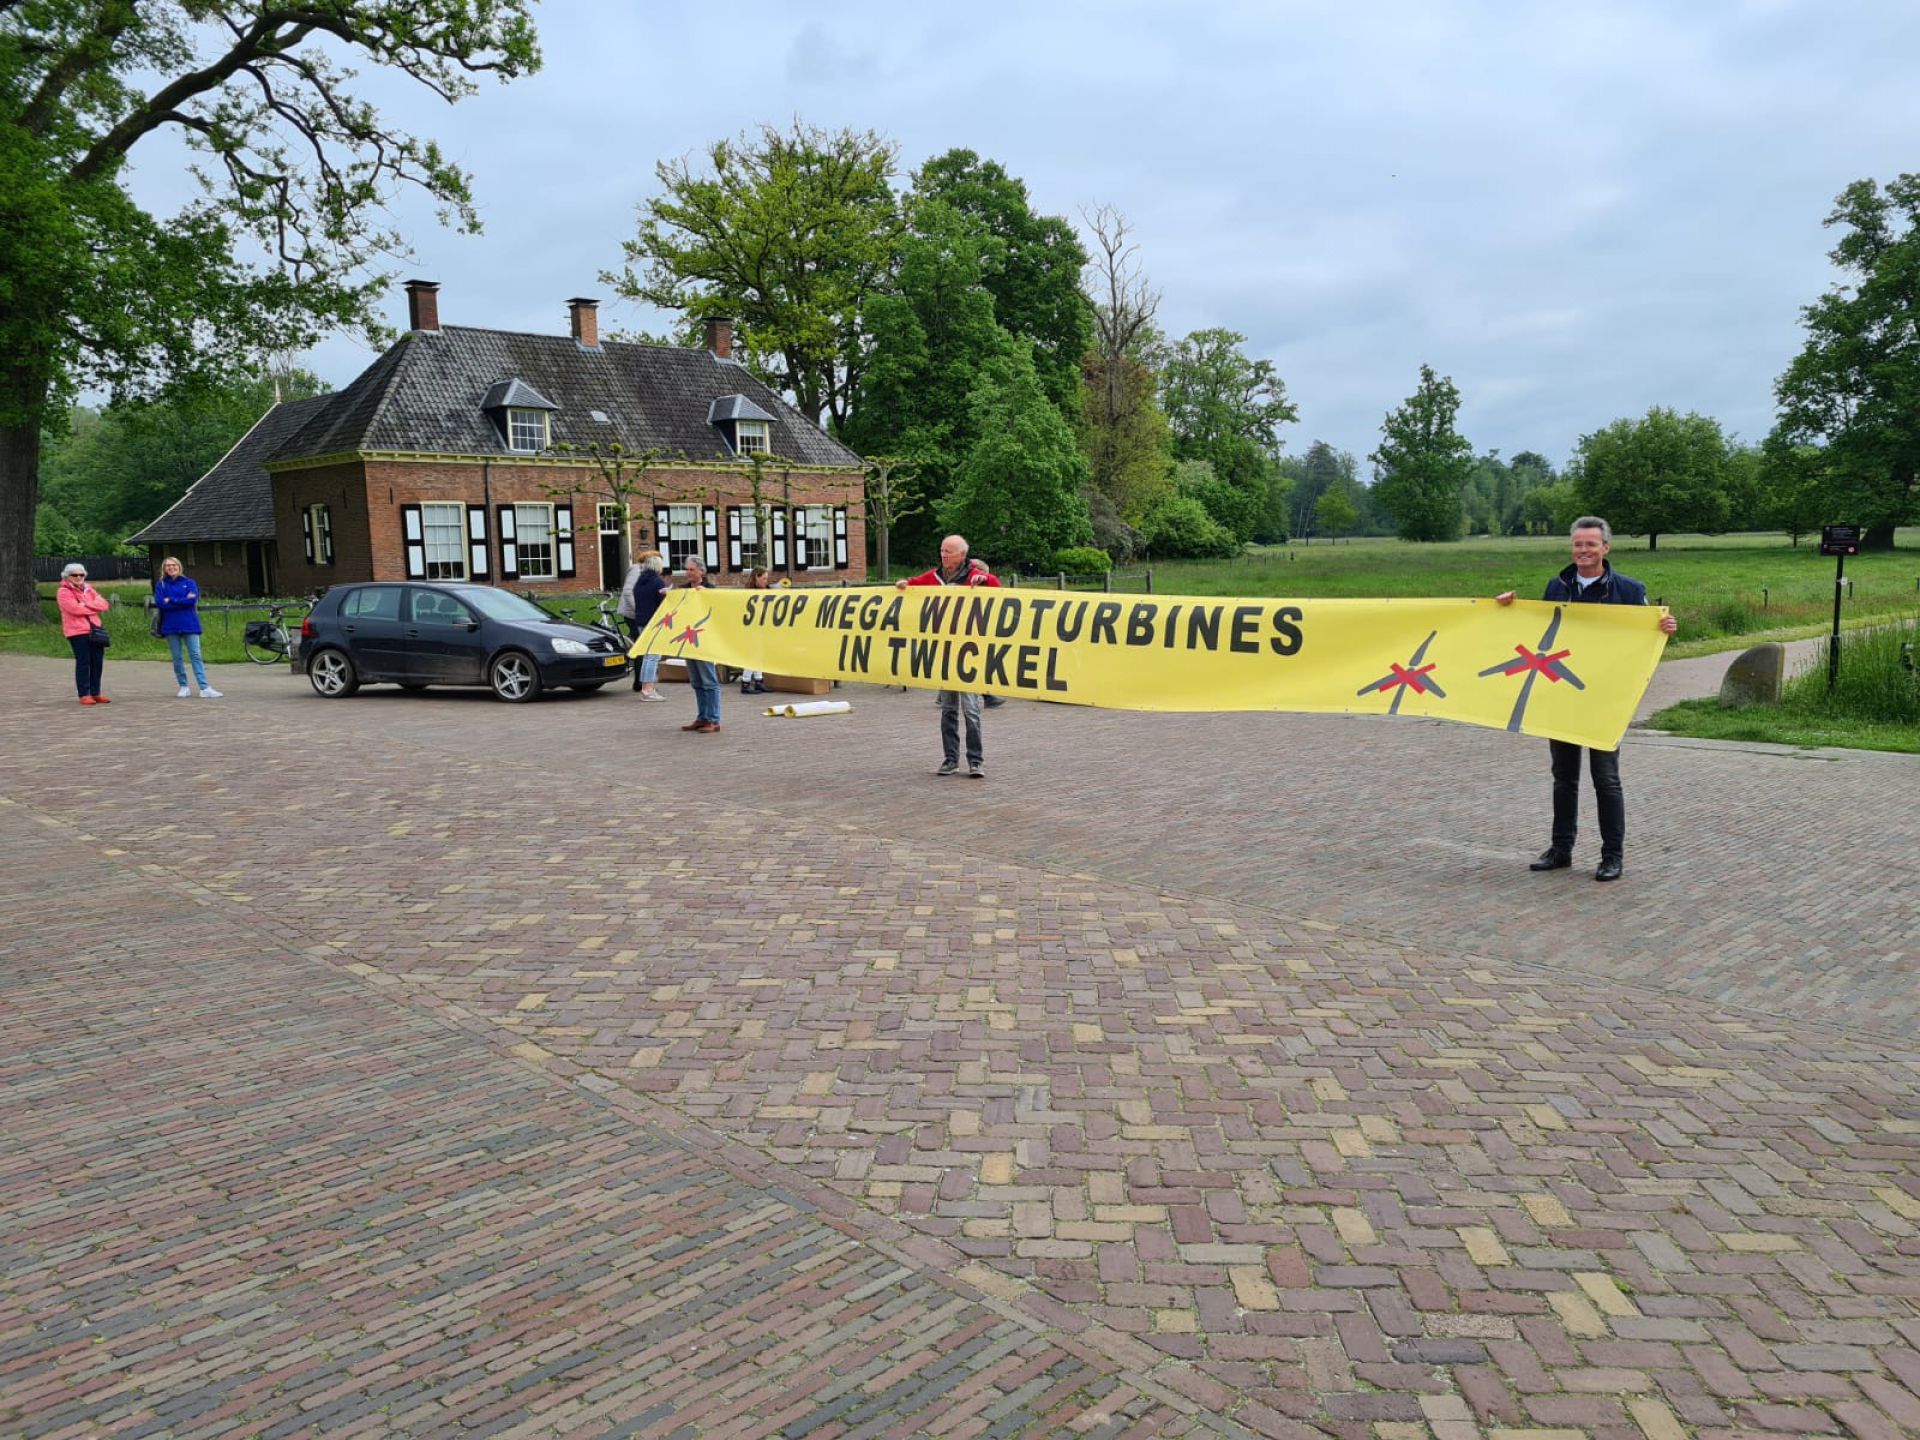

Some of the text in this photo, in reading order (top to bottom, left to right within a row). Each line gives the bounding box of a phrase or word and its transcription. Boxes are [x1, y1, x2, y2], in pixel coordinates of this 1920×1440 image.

[742, 594, 1304, 657] STOP MEGA WINDTURBINES
[838, 634, 1068, 691] IN TWICKEL
